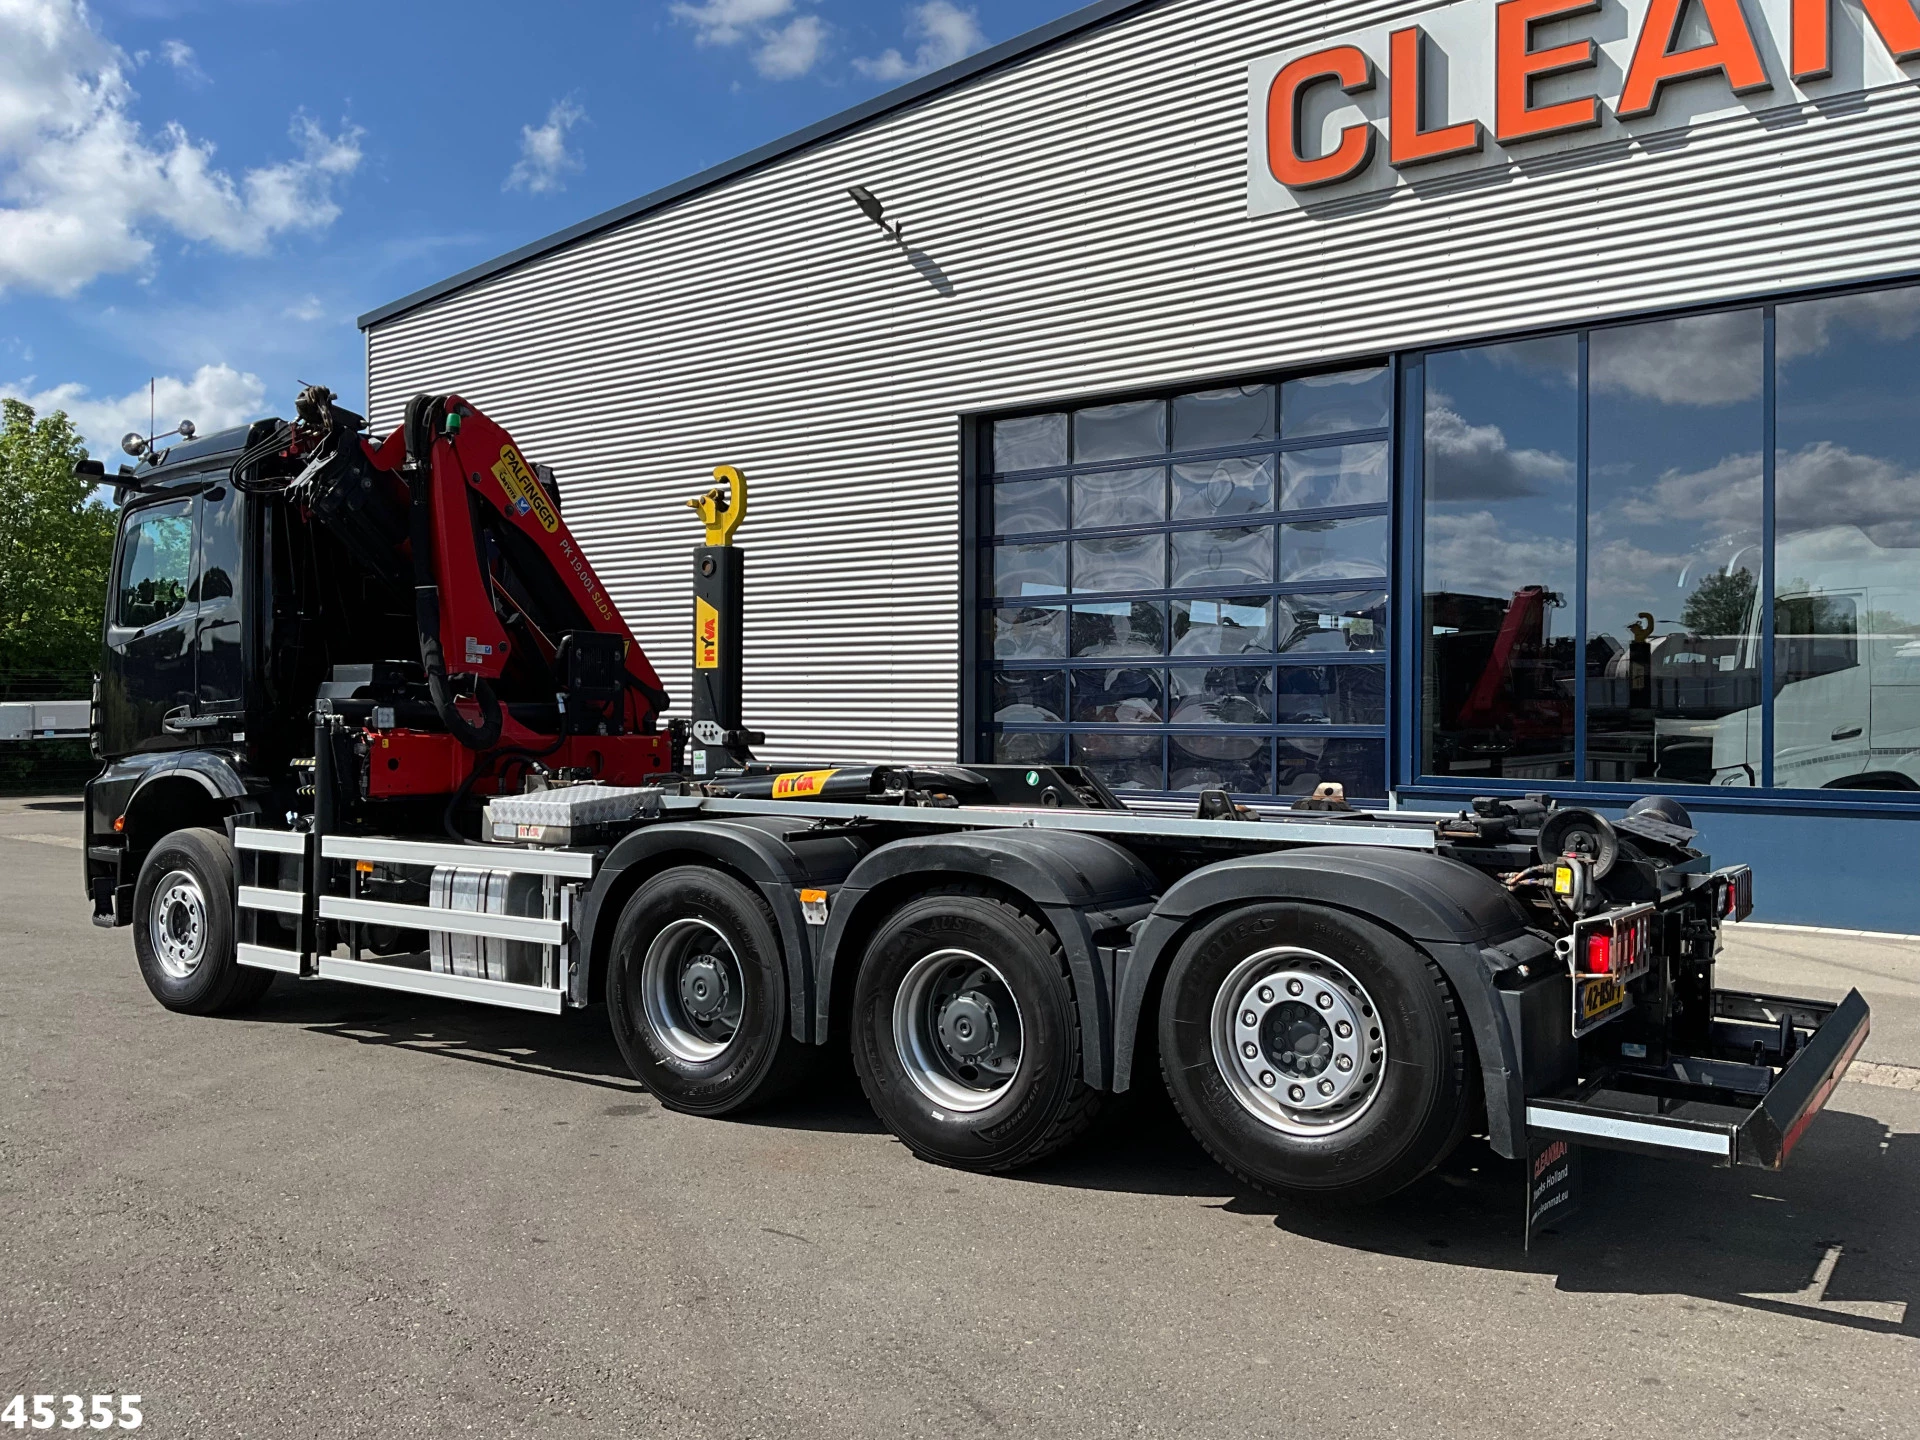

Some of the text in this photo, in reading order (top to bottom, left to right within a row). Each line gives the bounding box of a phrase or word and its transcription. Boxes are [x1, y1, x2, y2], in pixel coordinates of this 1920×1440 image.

[502, 448, 556, 530] PALFINGER
[559, 539, 574, 558] PK
[569, 556, 595, 593] 19.001
[700, 618, 716, 662] HYVA
[777, 774, 815, 793] HYVA
[1546, 1163, 1568, 1189] Holland
